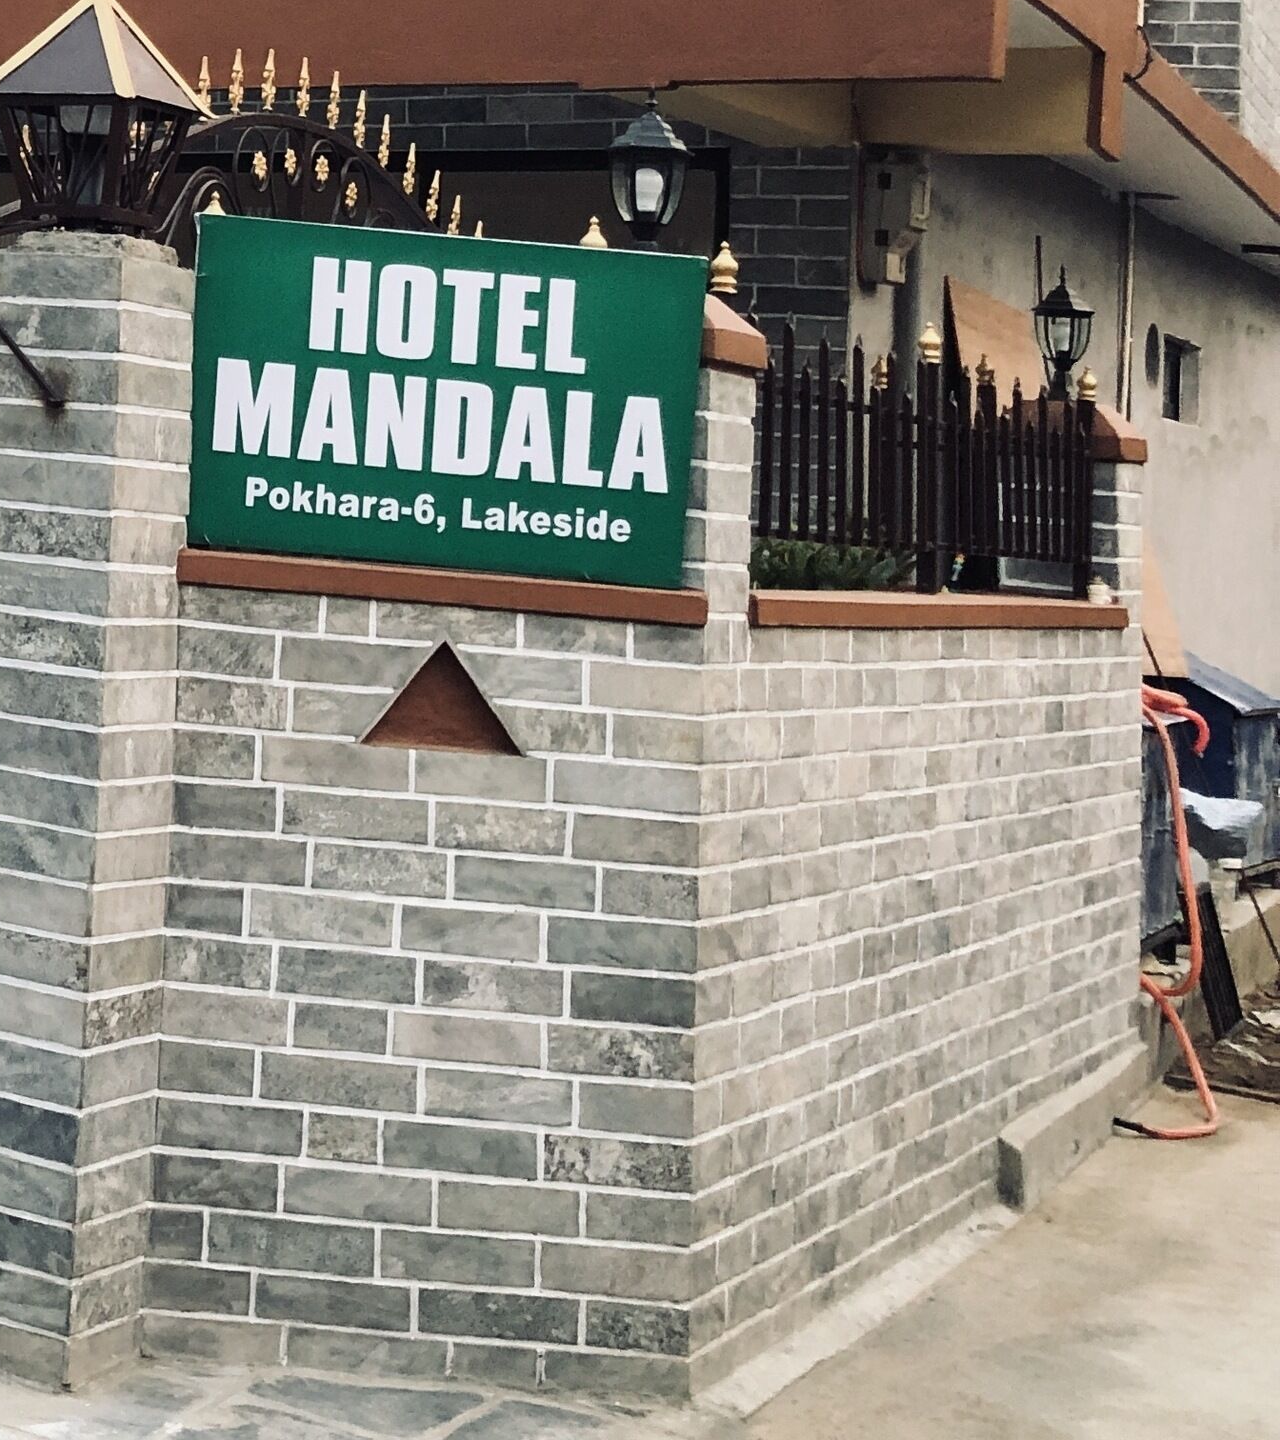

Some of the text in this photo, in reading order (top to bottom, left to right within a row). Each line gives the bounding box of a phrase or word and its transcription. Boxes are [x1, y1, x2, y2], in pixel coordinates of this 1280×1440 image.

[308, 256, 586, 374] HOTEL
[212, 357, 668, 494] MANDALA
[245, 476, 632, 543] Pokhara-6, Lakeside
